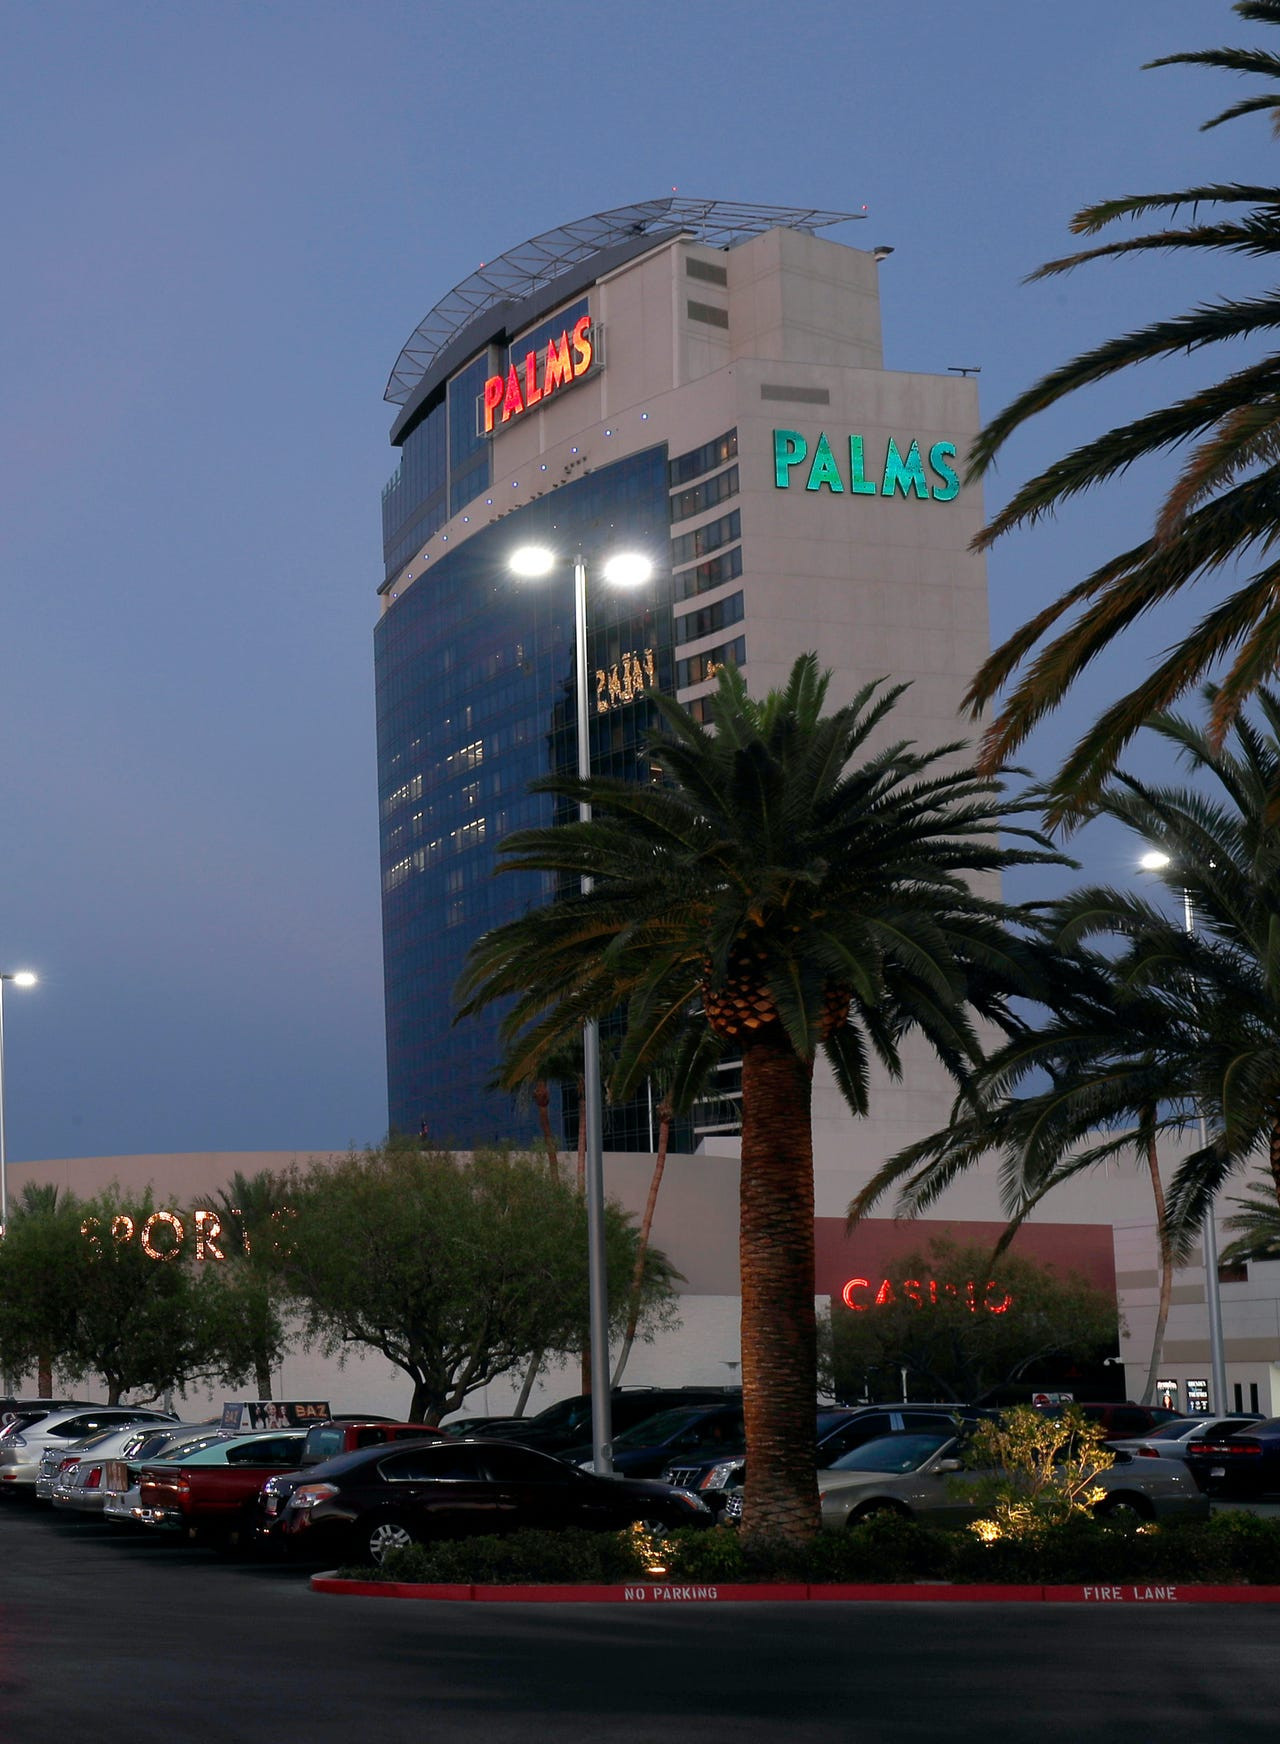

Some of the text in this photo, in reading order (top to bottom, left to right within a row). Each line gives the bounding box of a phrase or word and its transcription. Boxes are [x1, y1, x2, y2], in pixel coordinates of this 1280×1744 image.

[484, 316, 592, 432] PALMS
[774, 429, 959, 502] PALMS
[295, 1405, 327, 1418] BAZ
[624, 1587, 718, 1600] NO PARKING
[1083, 1587, 1177, 1600] FIRE LANE
